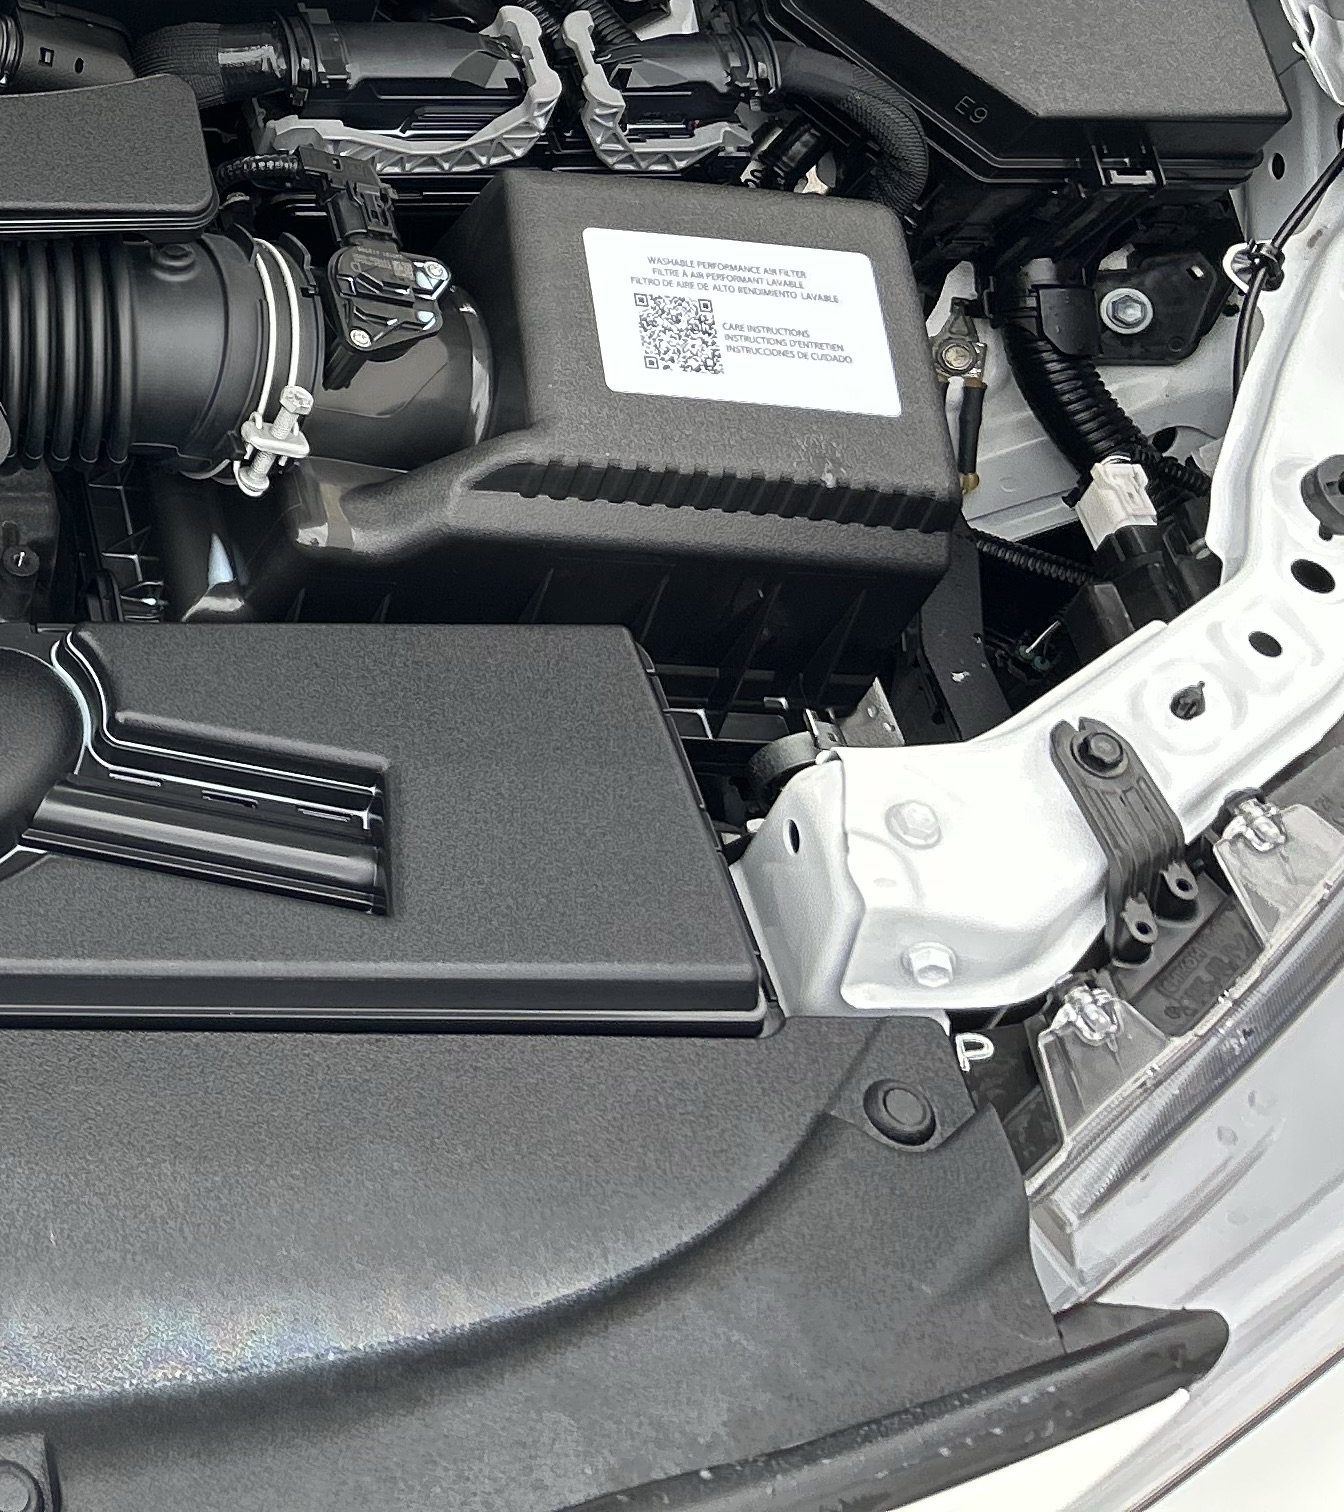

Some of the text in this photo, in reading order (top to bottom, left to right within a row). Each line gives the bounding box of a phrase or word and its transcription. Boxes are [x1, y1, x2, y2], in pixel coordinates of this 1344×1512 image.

[954, 95, 989, 124] E9
[647, 256, 695, 268] WASHABLE
[697, 260, 761, 274] PERFORMANCE
[778, 268, 807, 279] FILTER
[652, 268, 680, 278] FILTRE
[706, 272, 764, 286] PERFORMANT
[766, 277, 804, 289] LAVABLE
[630, 276, 661, 287] FILTRO
[662, 278, 674, 288] DE
[697, 282, 709, 291] DE
[712, 283, 736, 293] ALTO
[737, 286, 798, 299] RENDIMIENTO
[801, 292, 840, 303] LAVABLE
[722, 322, 810, 338] CARE INSTRUCTIONS
[724, 334, 787, 347] INSTRUCTIONS
[797, 351, 809, 360] DE
[955, 1032, 994, 1072] P
